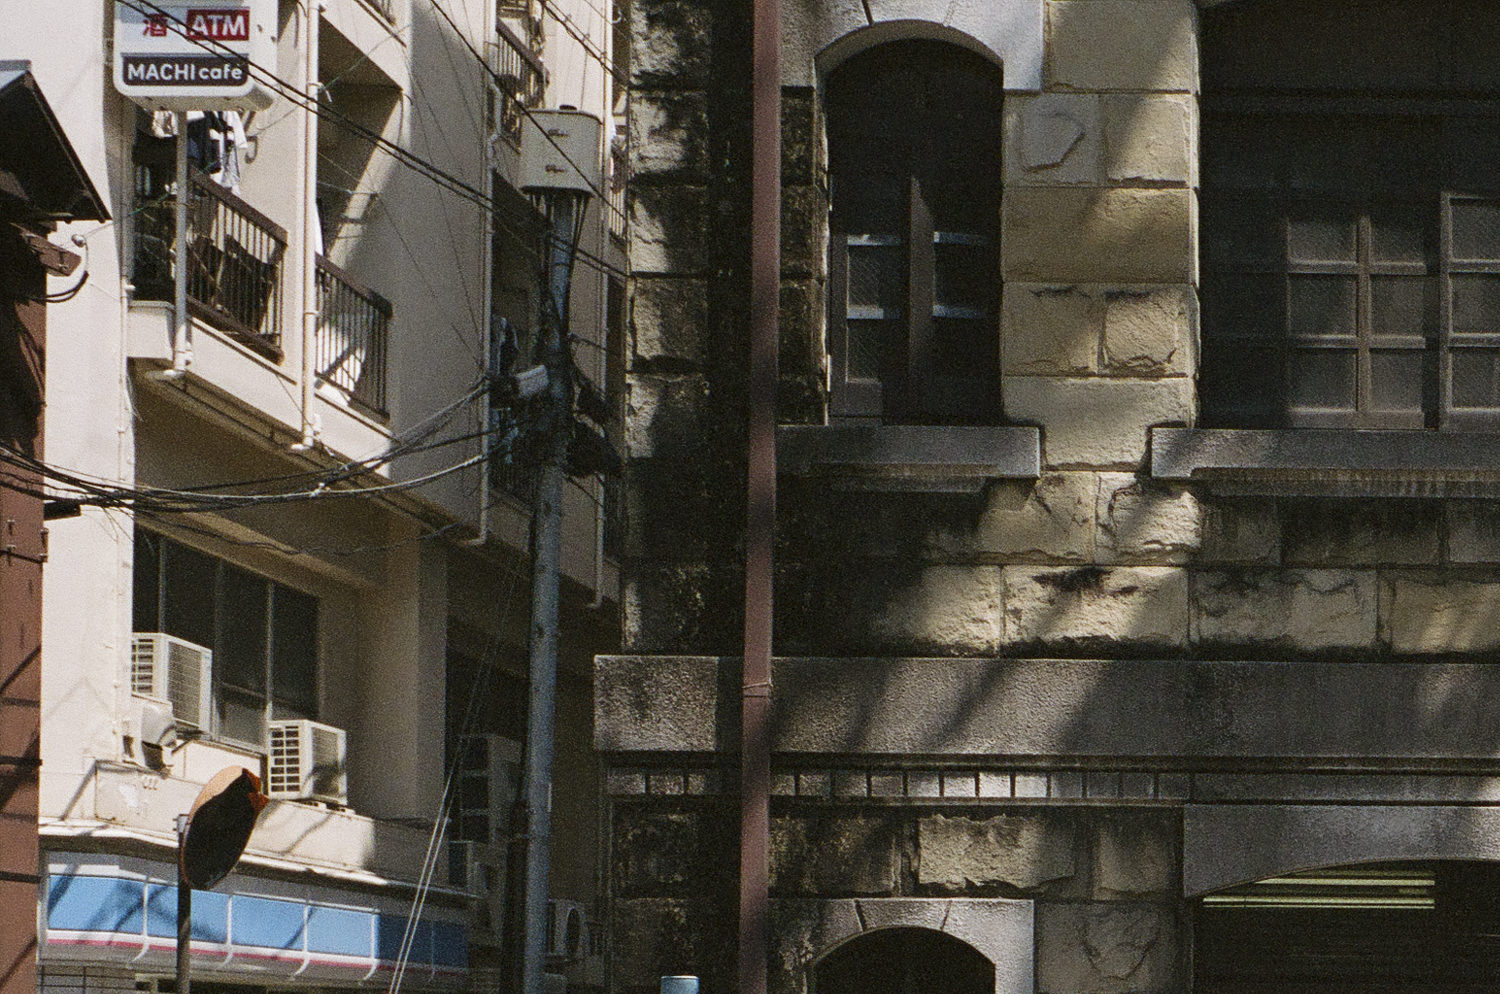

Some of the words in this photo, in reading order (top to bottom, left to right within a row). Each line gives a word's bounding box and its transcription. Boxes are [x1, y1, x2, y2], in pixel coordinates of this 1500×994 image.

[142, 13, 168, 37] 酒
[190, 14, 246, 36] ATM
[127, 63, 196, 81] MACHI
